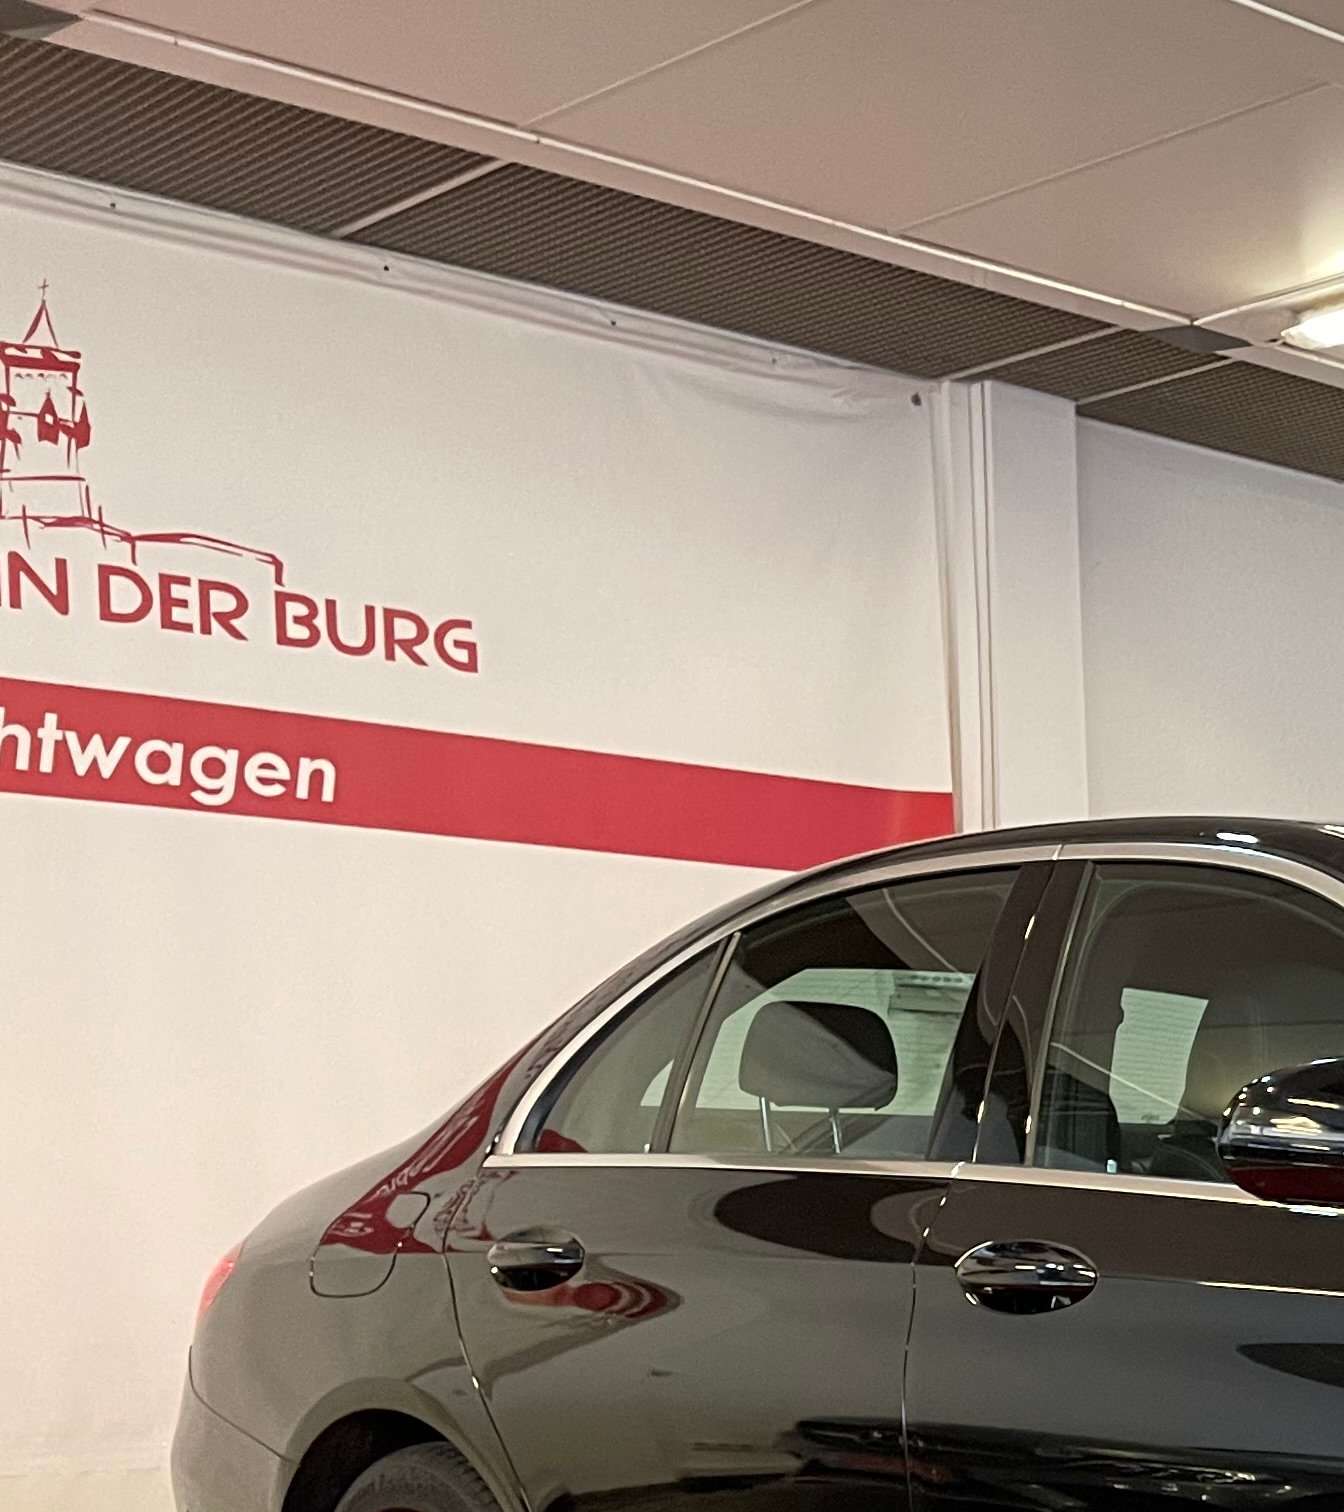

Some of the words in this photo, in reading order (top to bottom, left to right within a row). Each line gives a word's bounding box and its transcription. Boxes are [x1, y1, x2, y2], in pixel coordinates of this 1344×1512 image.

[0, 551, 69, 616] N
[97, 564, 248, 641] DER
[274, 589, 478, 673] BURG
